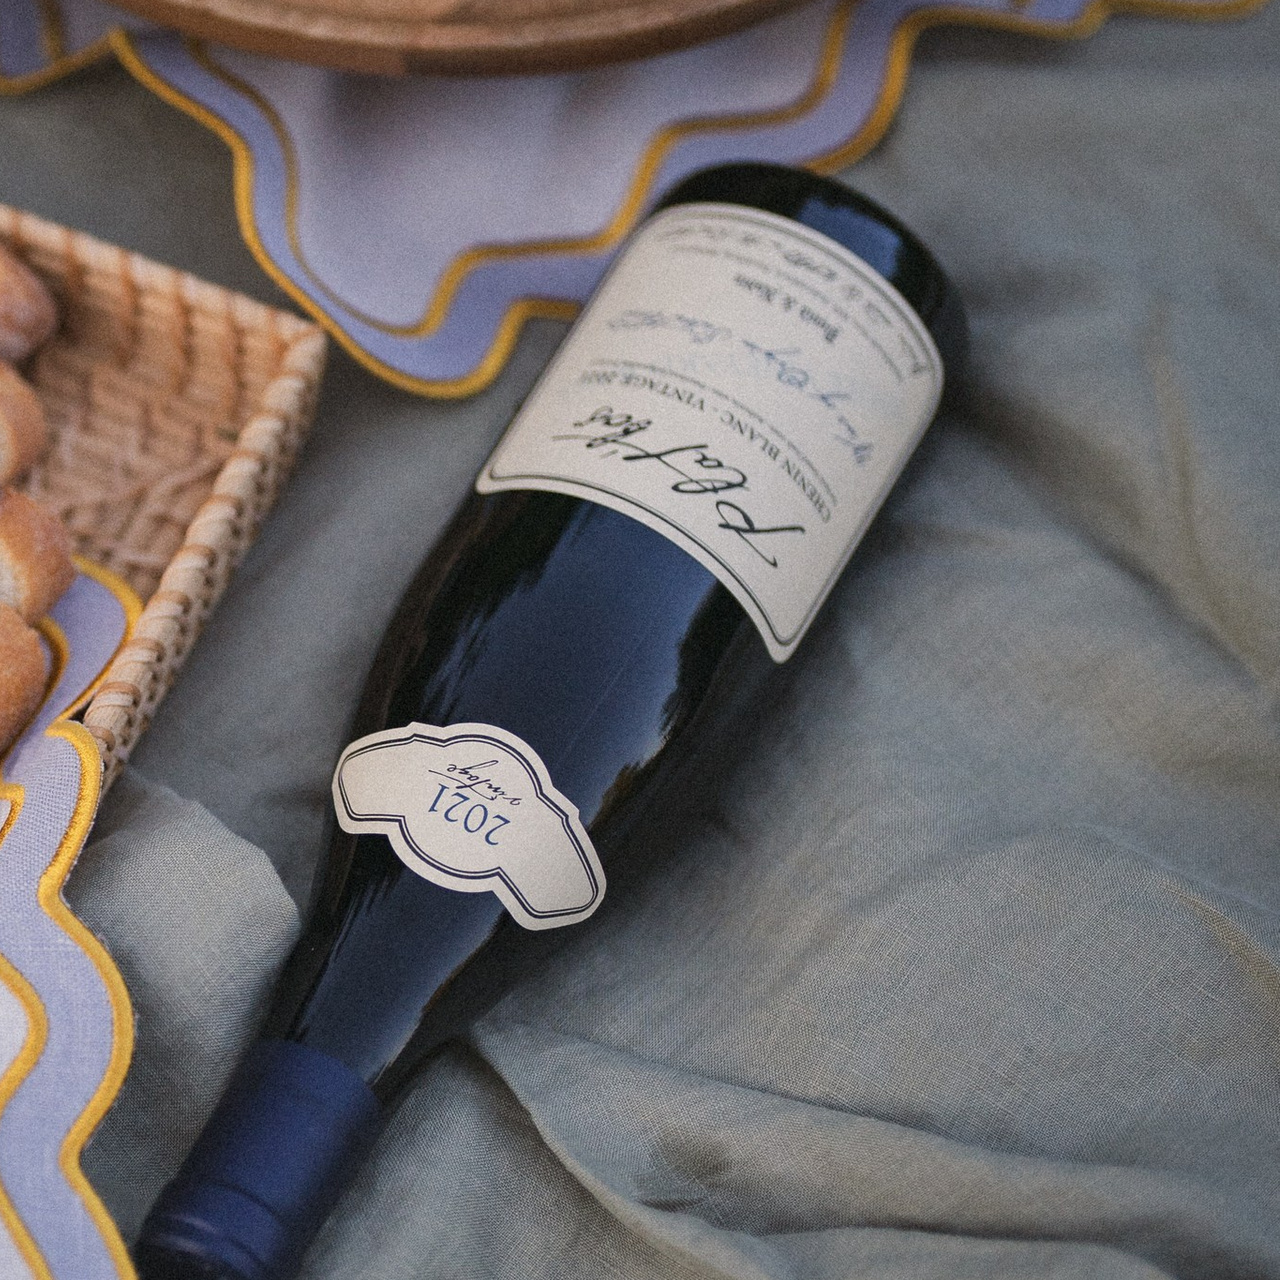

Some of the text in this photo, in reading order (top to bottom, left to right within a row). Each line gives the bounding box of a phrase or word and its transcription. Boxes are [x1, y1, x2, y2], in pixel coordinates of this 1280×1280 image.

[620, 373, 703, 412] VINTAGE
[718, 410, 781, 461] BLANC
[781, 457, 831, 523] CHENIN
[427, 759, 520, 806] vintage
[428, 782, 510, 845] 2021
